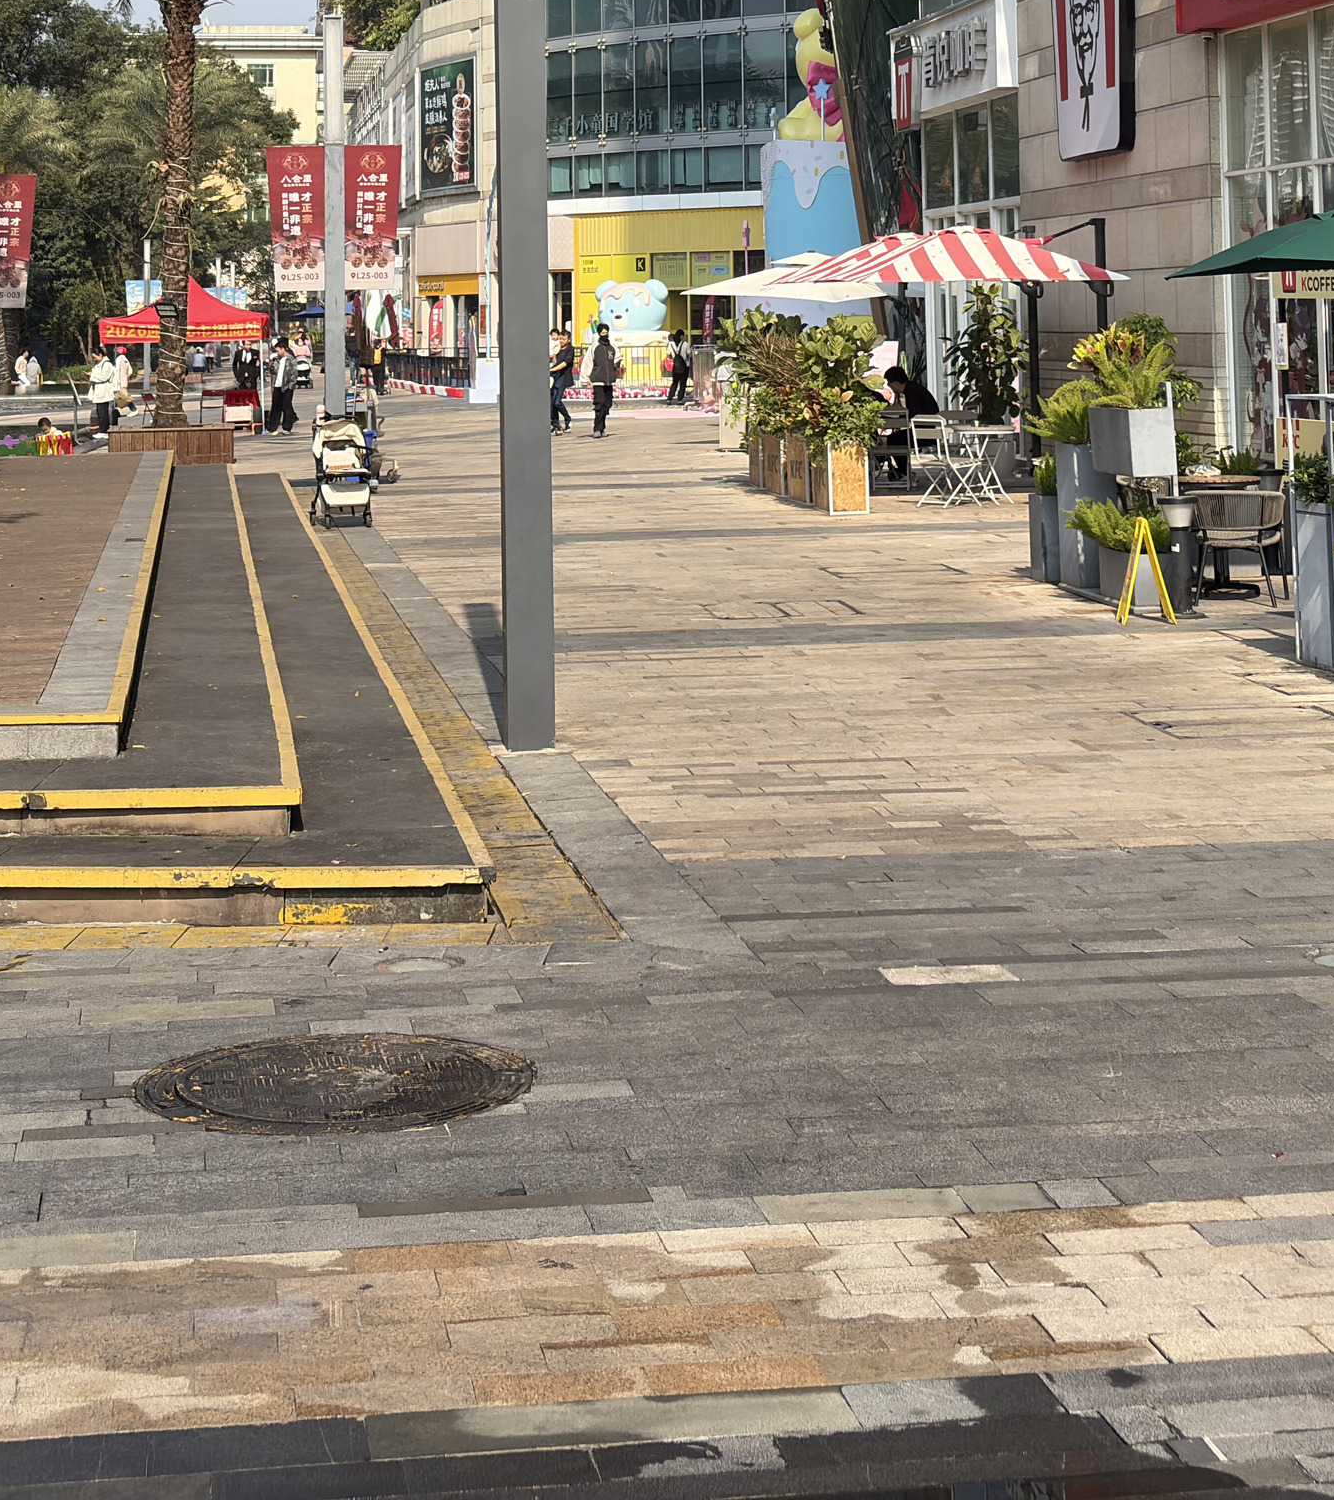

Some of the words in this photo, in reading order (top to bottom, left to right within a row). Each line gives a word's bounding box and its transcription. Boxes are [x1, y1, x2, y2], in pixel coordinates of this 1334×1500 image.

[280, 174, 313, 183] 八合里
[356, 173, 389, 182] 八合里
[301, 191, 313, 224] 才正宗
[375, 191, 388, 224] 才正宗
[9, 216, 22, 247] 才正宗
[287, 272, 320, 281] L2S-003
[357, 271, 389, 280] L2S-003
[1282, 433, 1300, 449] KC
